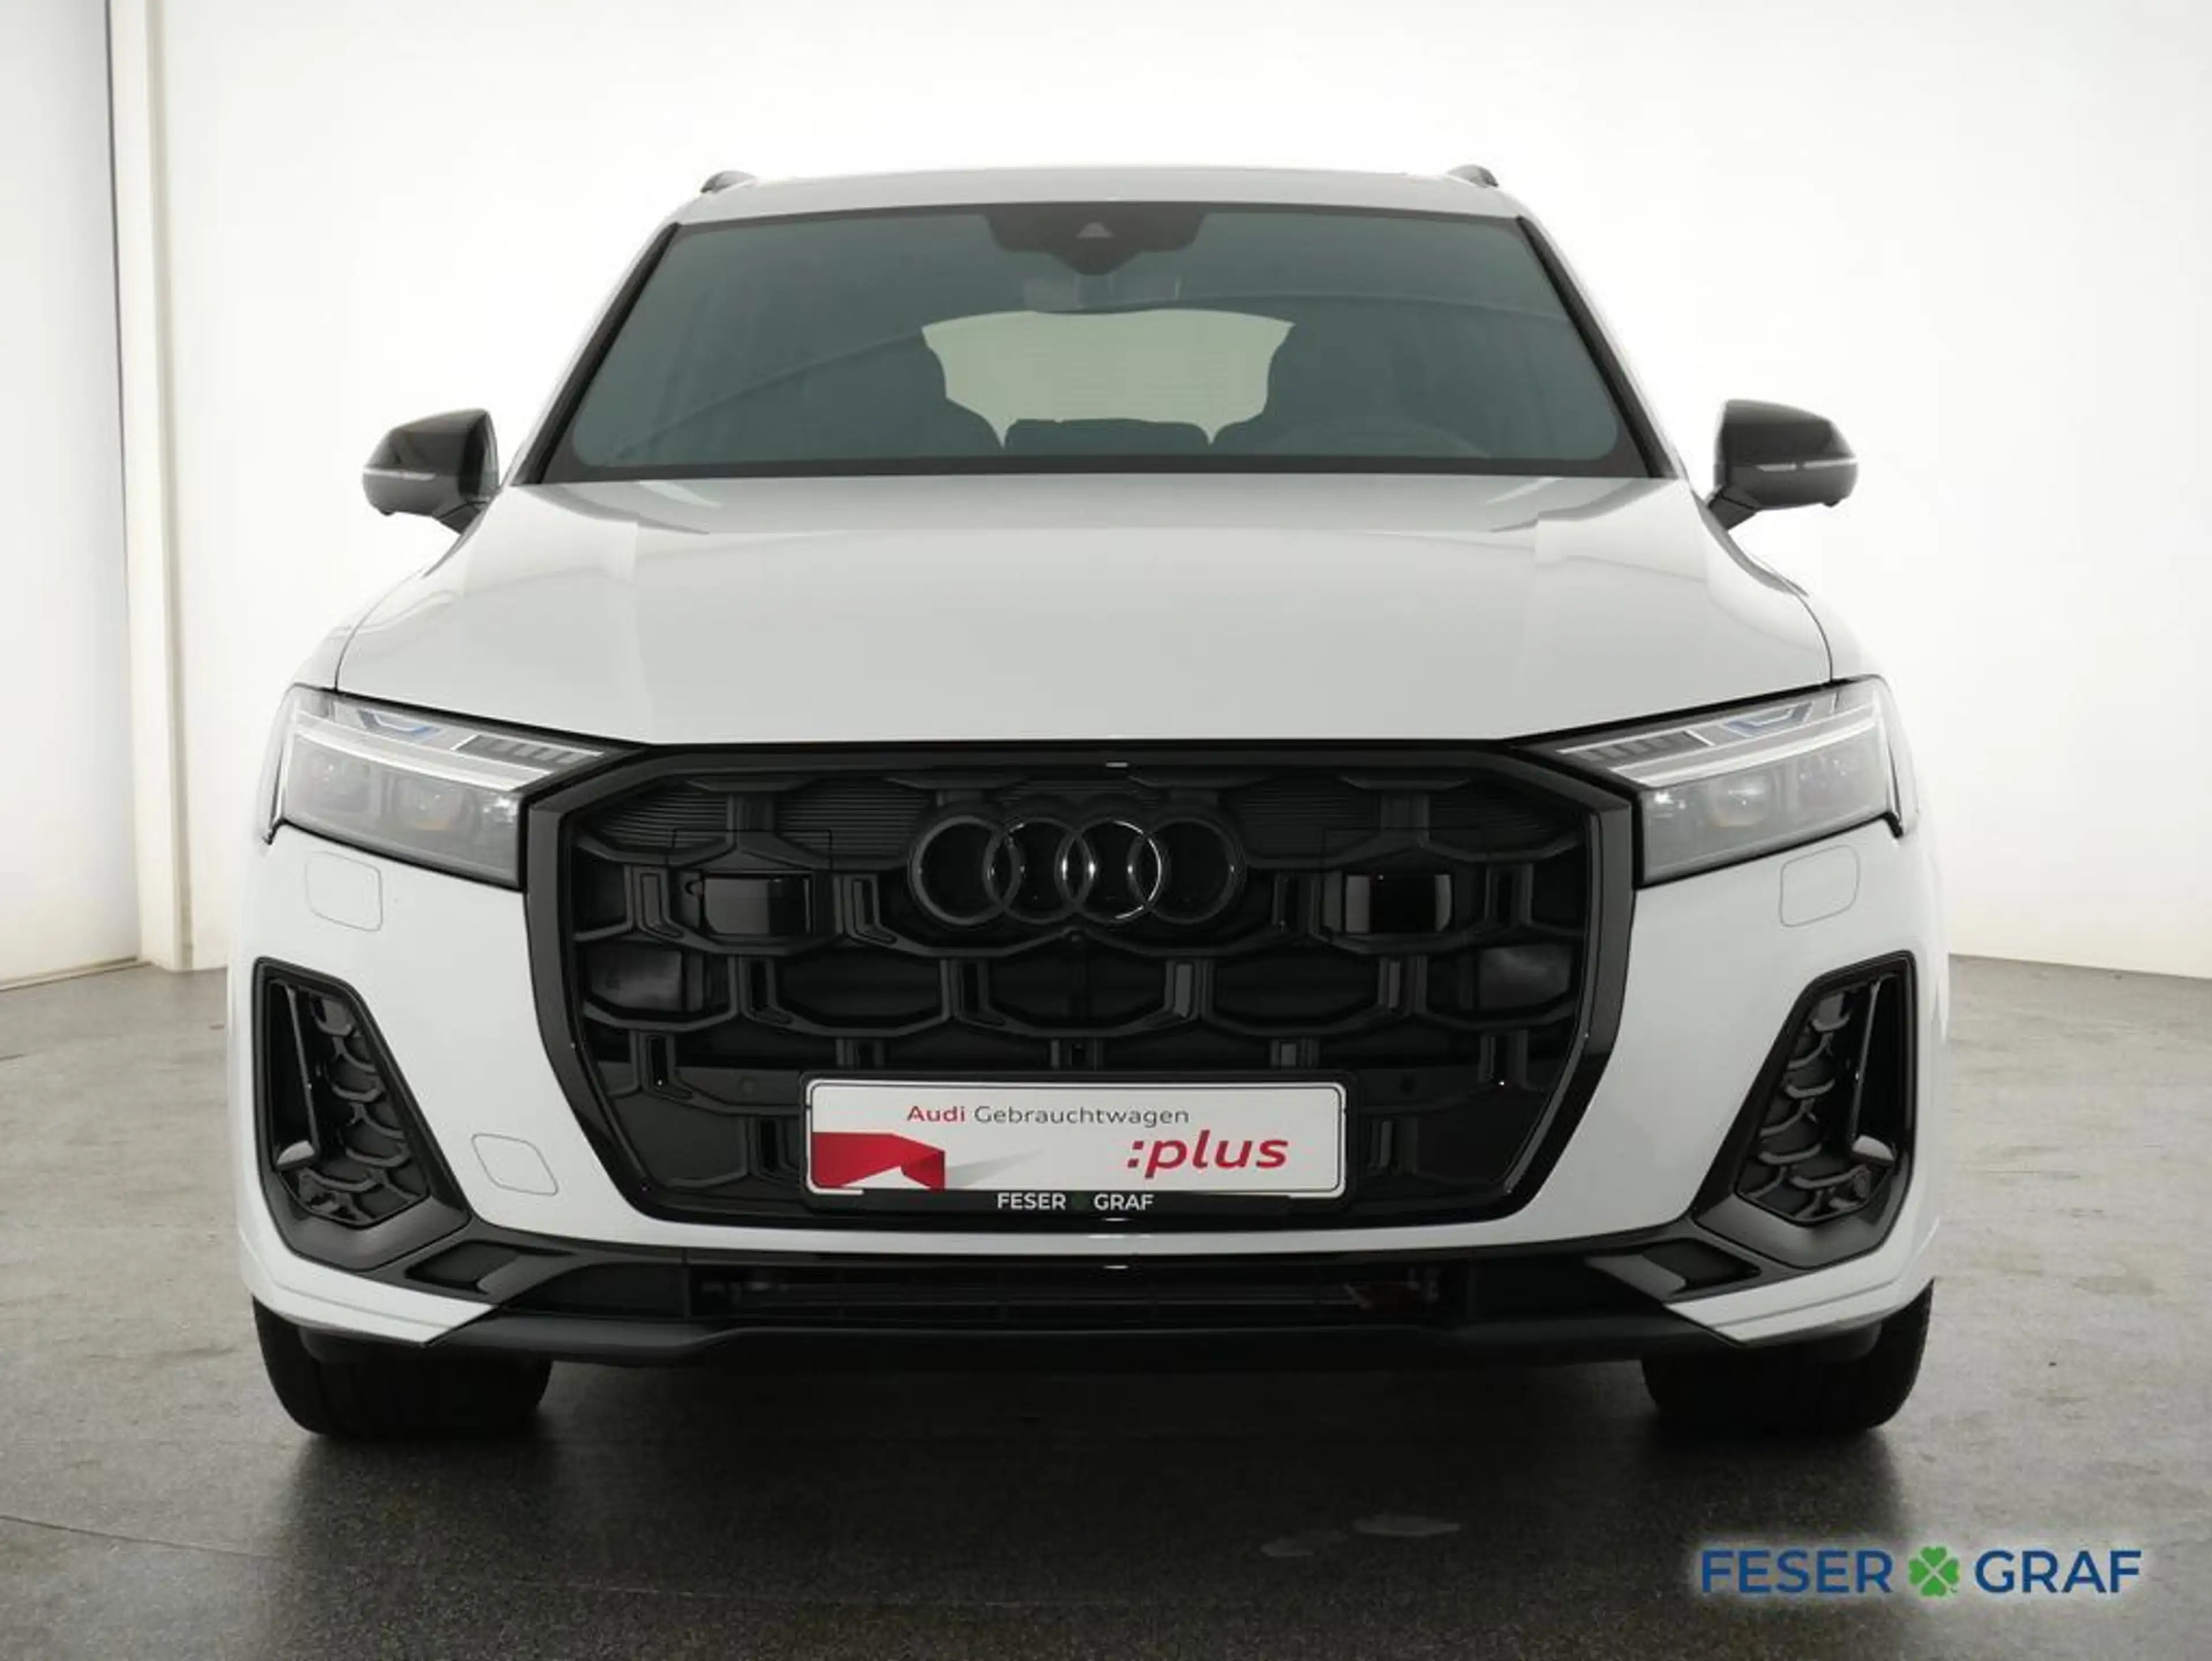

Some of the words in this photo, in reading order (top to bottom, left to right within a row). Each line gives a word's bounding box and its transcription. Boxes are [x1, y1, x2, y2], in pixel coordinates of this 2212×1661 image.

[907, 1104, 965, 1123] Audi
[974, 1106, 1189, 1128] Gebrauchtwagen
[1125, 1129, 1290, 1178] :plus
[997, 1193, 1066, 1211] FESER
[1094, 1193, 1154, 1211] GRAF
